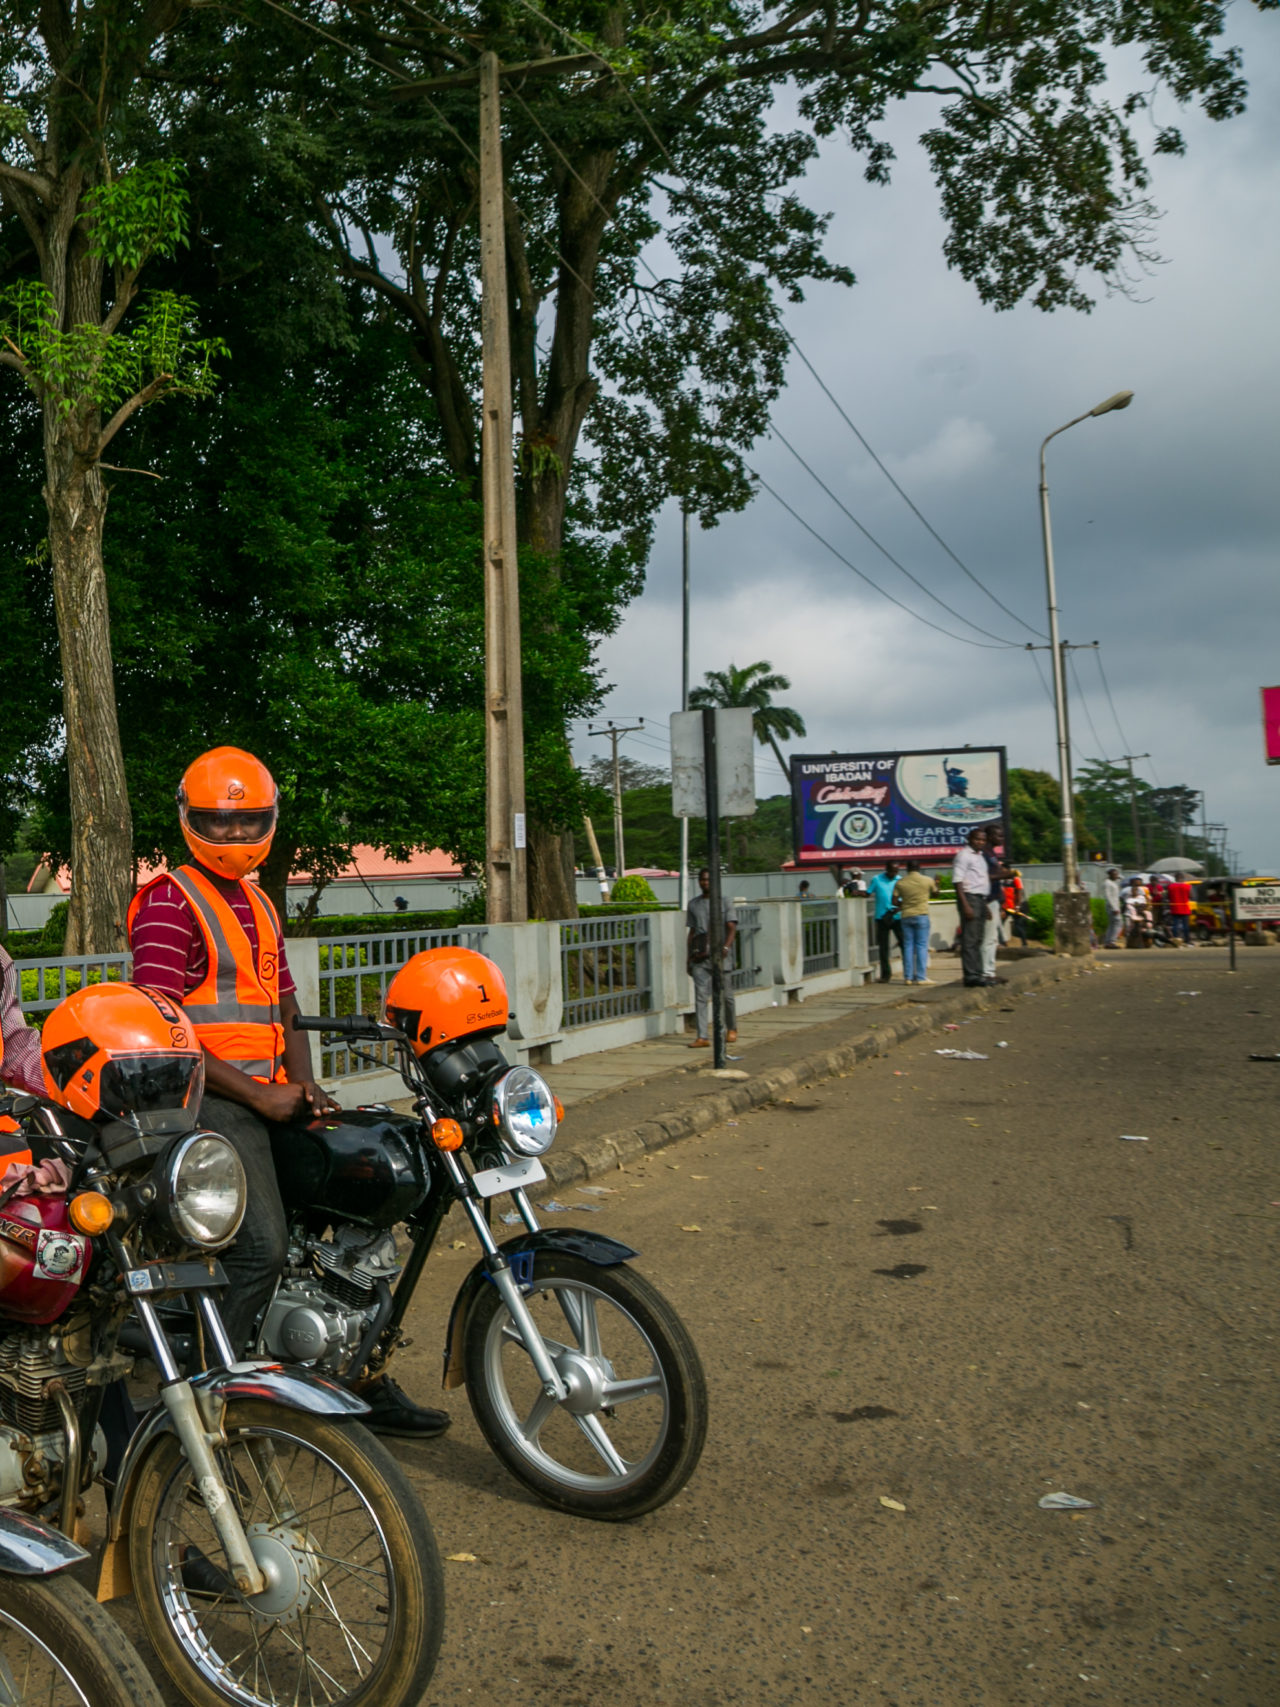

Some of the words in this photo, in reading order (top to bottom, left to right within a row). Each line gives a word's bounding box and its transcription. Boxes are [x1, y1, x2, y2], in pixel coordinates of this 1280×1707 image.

[801, 761, 875, 774] UNIVERSITY
[876, 760, 895, 770] OF
[825, 771, 872, 783] IBADAN
[904, 827, 955, 838] YEARS
[893, 836, 970, 847] EXCELLEN
[1256, 888, 1275, 896] NO
[477, 984, 491, 1003] 1
